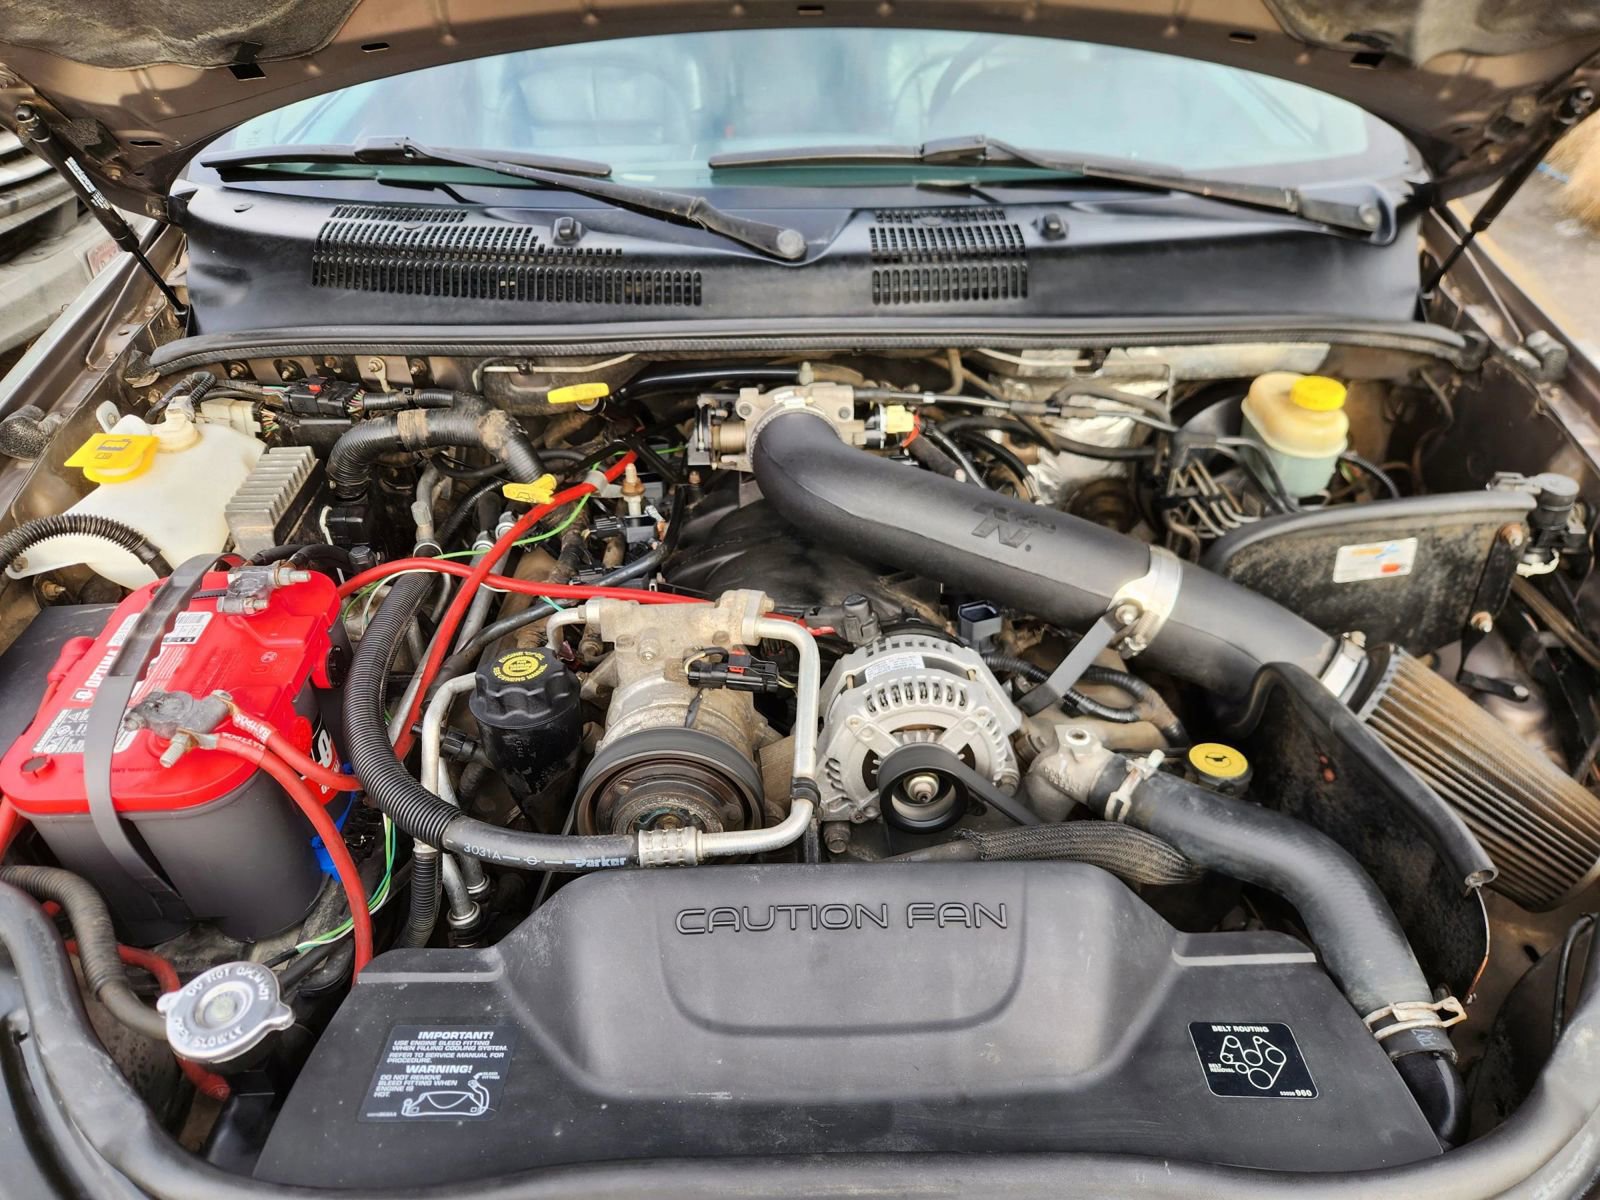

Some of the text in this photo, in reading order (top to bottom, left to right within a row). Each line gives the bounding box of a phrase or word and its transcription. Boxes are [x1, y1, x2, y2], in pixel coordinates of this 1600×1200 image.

[84, 648, 120, 687] OPTIMA
[463, 842, 501, 861] 3031A
[675, 902, 1007, 934] CAUTION FAN
[207, 967, 231, 983] NOT
[417, 1031, 494, 1040] IMPORTANT!
[1233, 1025, 1270, 1033] ROUTING
[405, 1065, 473, 1074] WARNING!
